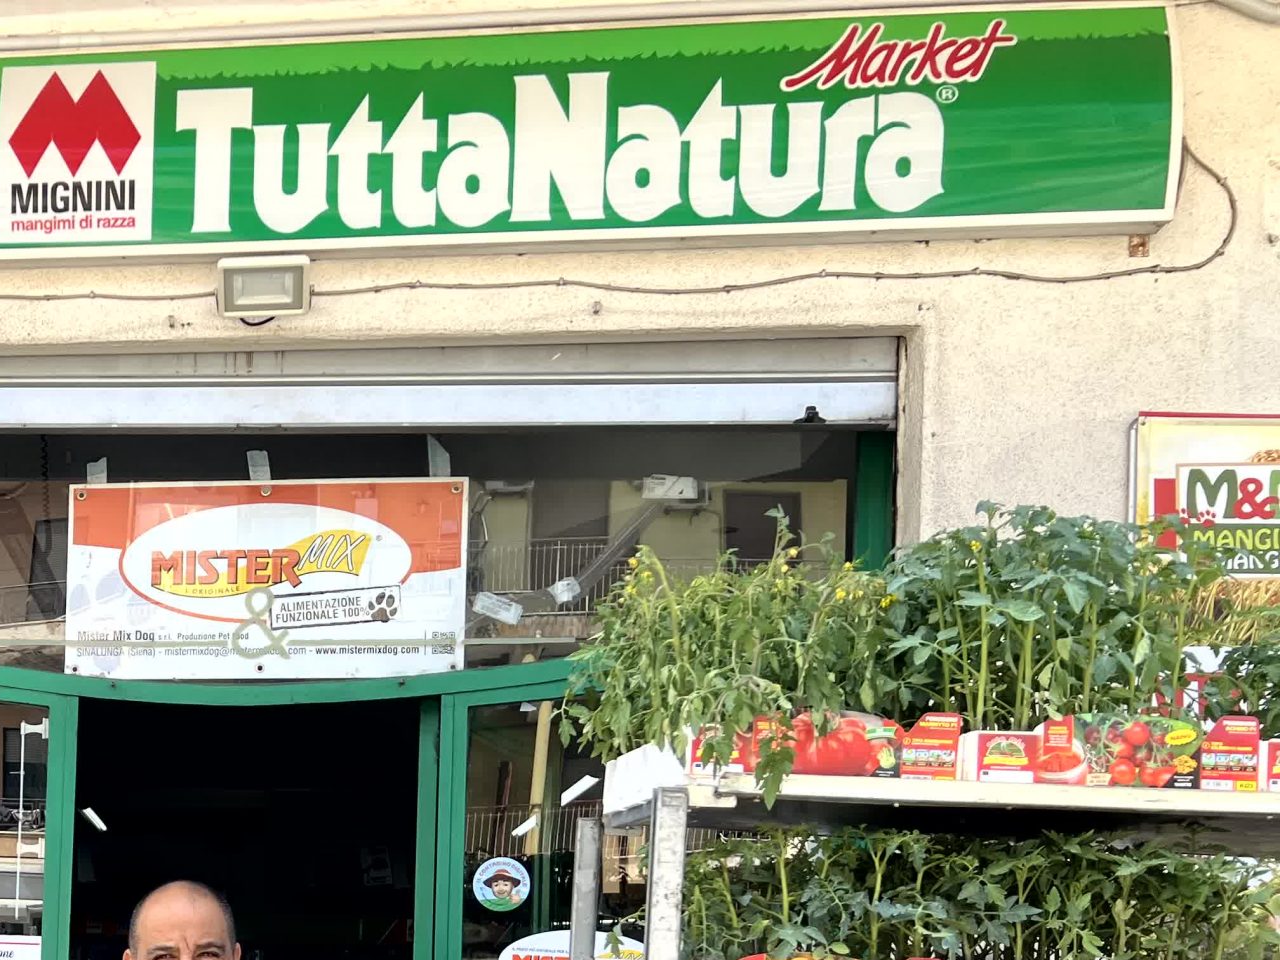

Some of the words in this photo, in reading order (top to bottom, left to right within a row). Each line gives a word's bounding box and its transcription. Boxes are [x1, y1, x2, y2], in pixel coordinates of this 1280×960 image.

[781, 18, 1017, 91] Market
[175, 71, 945, 233] TuttaNatura
[11, 179, 136, 214] MIGNINI
[11, 215, 75, 234] mangimi
[79, 214, 93, 229] di
[96, 216, 136, 229] razza
[1186, 468, 1280, 519] M&
[1193, 528, 1280, 550] MANGI
[151, 549, 303, 588] MISTER
[297, 534, 366, 571] MIX
[275, 608, 339, 623] FUNZIONALE
[280, 596, 362, 613] ALIMENTAZIONE
[77, 630, 110, 641] Mister
[113, 630, 131, 641] Mix
[135, 630, 155, 642] Dog
[177, 632, 216, 640] Produzione
[218, 632, 230, 640] Pet
[76, 647, 125, 657] SINALUNGA
[315, 646, 420, 656] www.mistermixdog.com
